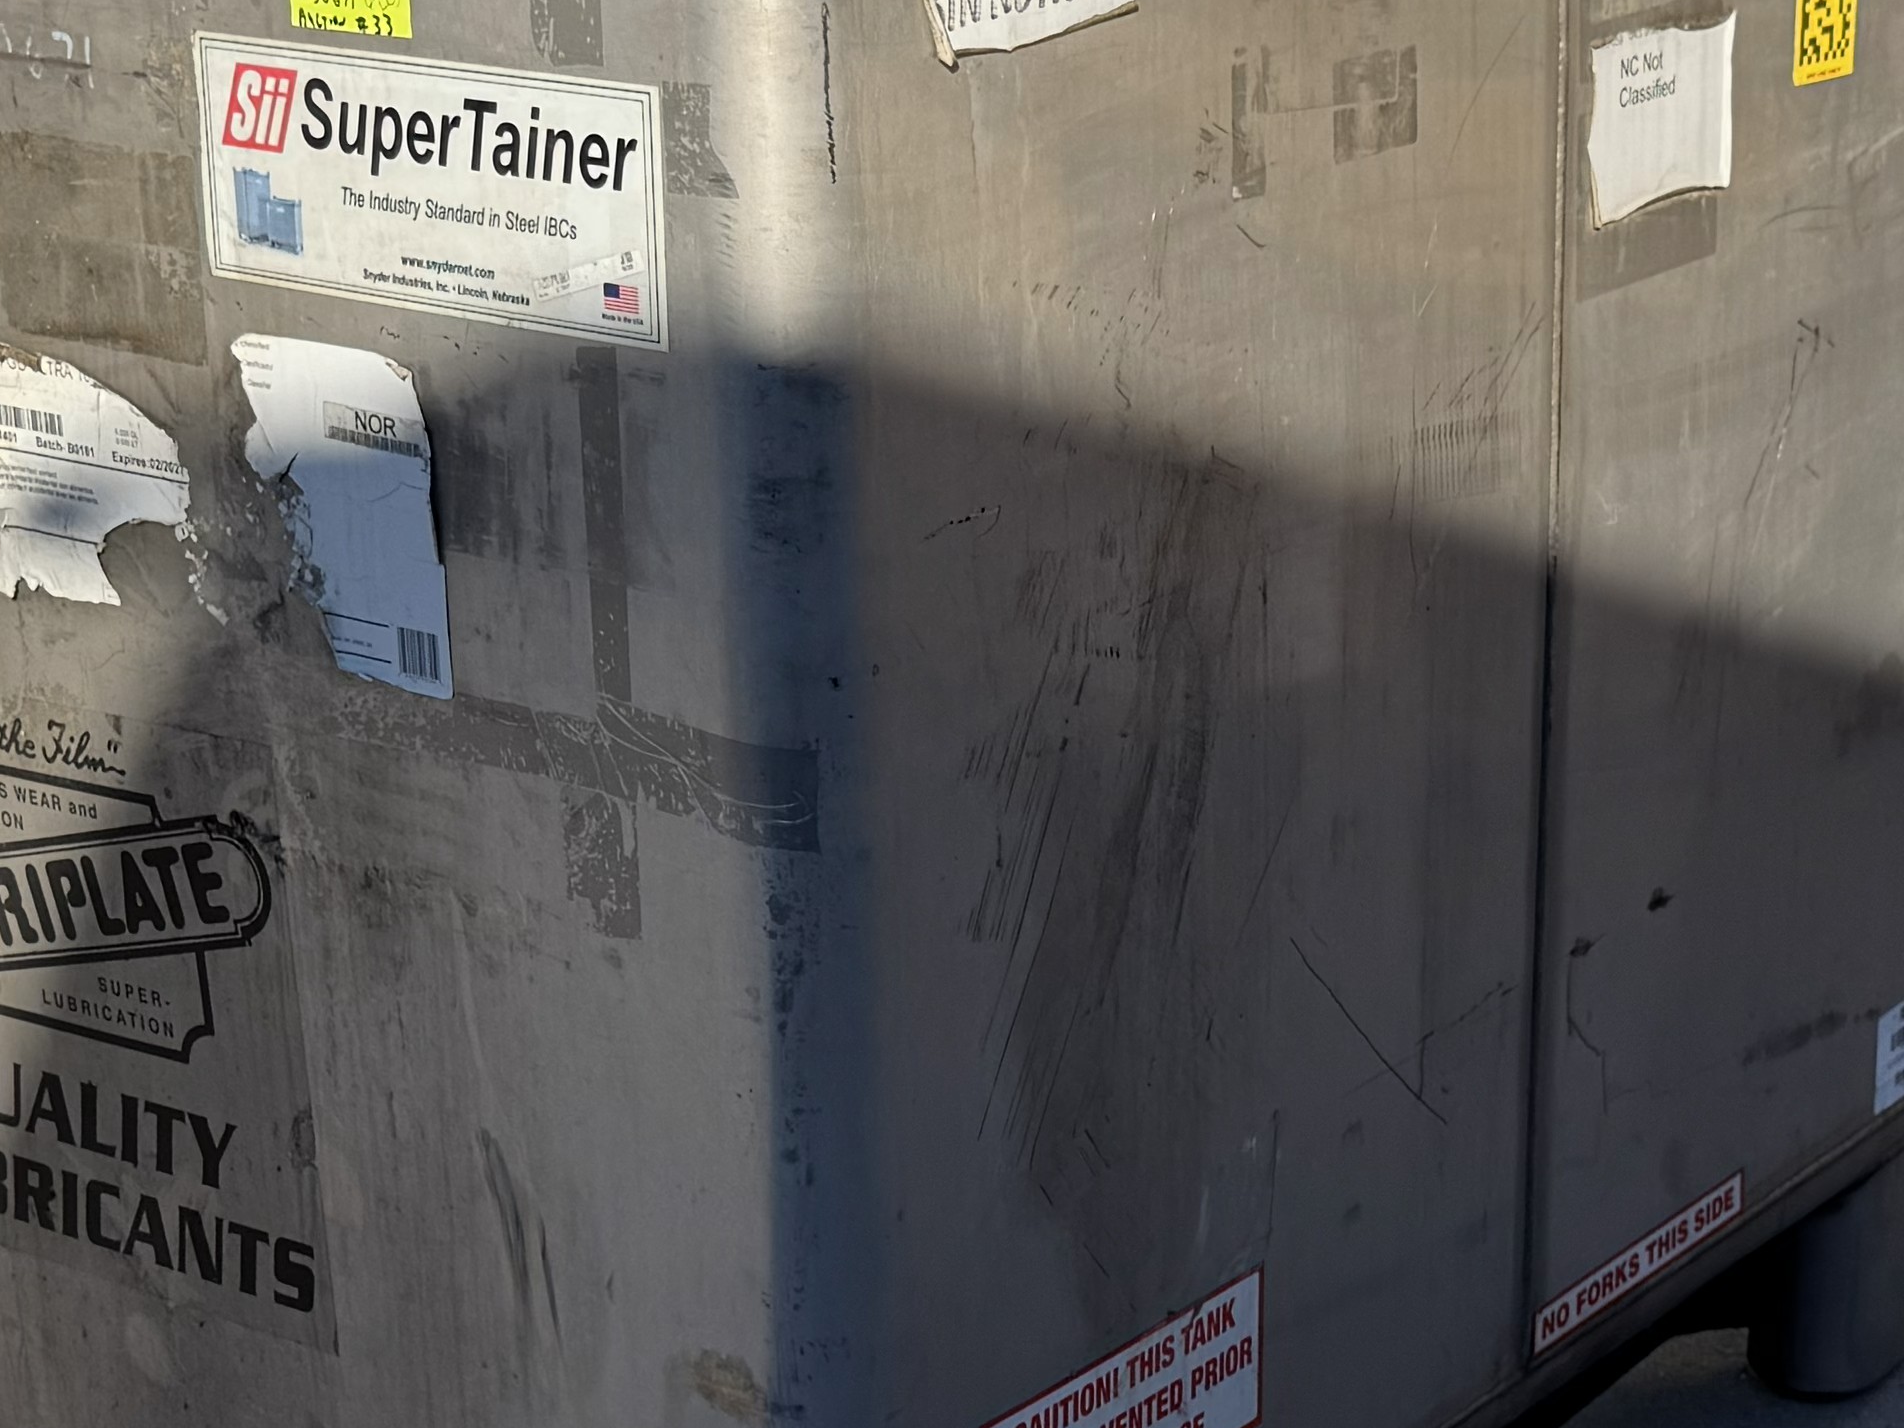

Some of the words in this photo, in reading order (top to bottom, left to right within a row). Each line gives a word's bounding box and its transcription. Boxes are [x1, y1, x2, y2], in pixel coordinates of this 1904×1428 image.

[1619, 73, 1677, 109] Classified
[1620, 54, 1640, 79] NC
[1642, 48, 1664, 73] Not
[230, 69, 290, 147] Sii
[300, 76, 638, 192] SuperTainer
[341, 185, 365, 208] The
[369, 189, 421, 221] Industry
[424, 198, 486, 227] Standard
[488, 209, 501, 228] in
[504, 211, 540, 236] Steel
[544, 215, 578, 241] IBCs
[14, 784, 63, 813] WEAR
[68, 798, 98, 820] and
[41, 988, 175, 1039] LUBRICATION
[1541, 1301, 1571, 1342] NO
[1576, 1252, 1641, 1316] FORKS
[1646, 1218, 1689, 1265] THIS
[1694, 1183, 1736, 1234] SIDE
[1126, 1334, 1176, 1389] THIS
[1181, 1297, 1237, 1356] TANK
[1190, 1334, 1253, 1400] PRIOR
